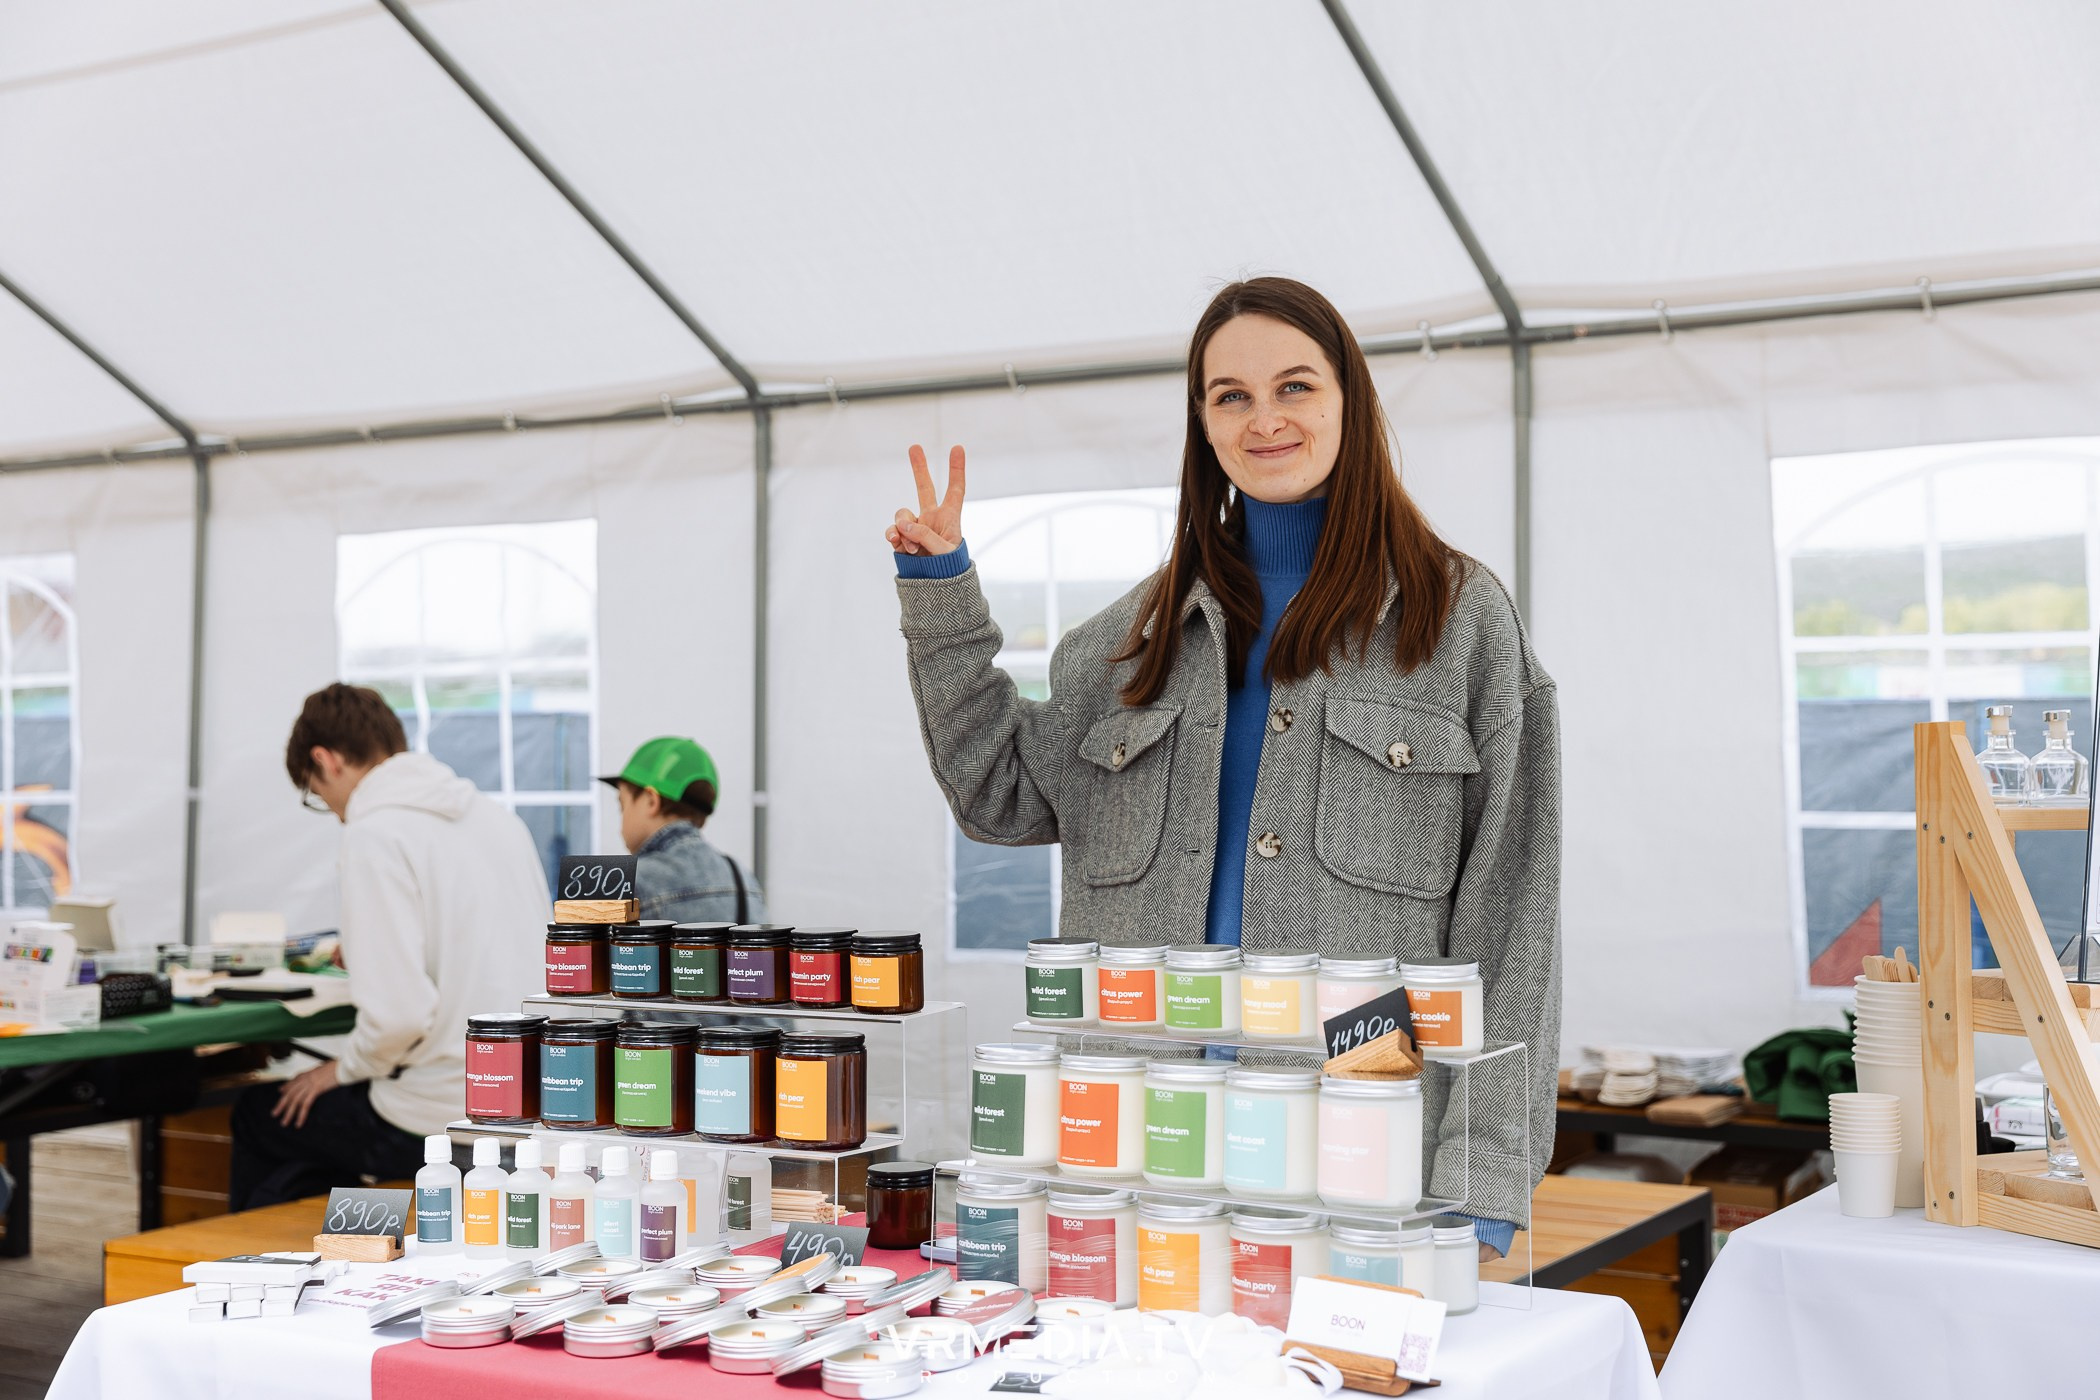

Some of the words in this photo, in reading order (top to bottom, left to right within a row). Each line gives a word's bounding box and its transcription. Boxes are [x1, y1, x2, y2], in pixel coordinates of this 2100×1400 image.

[559, 963, 587, 971] blossom
[638, 963, 652, 972] trip
[684, 966, 704, 975] forest
[745, 968, 764, 977] plum
[810, 973, 831, 981] party
[863, 977, 880, 985] pear
[1177, 975, 1193, 983] BOON
[1031, 986, 1044, 995] wild
[1045, 987, 1067, 996] forest
[1101, 988, 1117, 997] citrus
[1118, 990, 1143, 999] power
[1167, 995, 1183, 1003] green
[1184, 995, 1210, 1004] dream
[1263, 1000, 1286, 1009] mood
[1421, 1012, 1451, 1022] cookie
[476, 1043, 493, 1051] BOON
[550, 1046, 566, 1054] BOON
[625, 1050, 641, 1058] BOON
[704, 1056, 720, 1064] BOON
[781, 1061, 797, 1069] BOON
[483, 1073, 514, 1081] blossom
[980, 1074, 996, 1082] BOON
[569, 1078, 584, 1087] trip
[632, 1081, 657, 1090] dream
[1069, 1083, 1087, 1091] BOON
[719, 1089, 737, 1097] vibe
[1155, 1090, 1174, 1098] BOON
[788, 1095, 805, 1103] pear
[984, 1106, 1005, 1117] forest
[1075, 1118, 1102, 1127] power
[1162, 1125, 1189, 1136] dream
[1242, 1136, 1266, 1146] coast
[441, 1209, 452, 1217] trip
[969, 1207, 987, 1216] BOON
[1062, 1219, 1084, 1227] BOON
[1148, 1231, 1167, 1241] BOON
[958, 1239, 990, 1251] caribbean
[991, 1242, 1007, 1253] trip
[1239, 1243, 1259, 1253] BOON
[1049, 1251, 1071, 1263] orange
[1071, 1253, 1107, 1264] blossom
[1345, 1255, 1367, 1266] BOON
[1143, 1264, 1155, 1275] rich
[1155, 1268, 1176, 1278] pear
[1252, 1282, 1277, 1293] party
[1331, 1313, 1366, 1331] BOON
